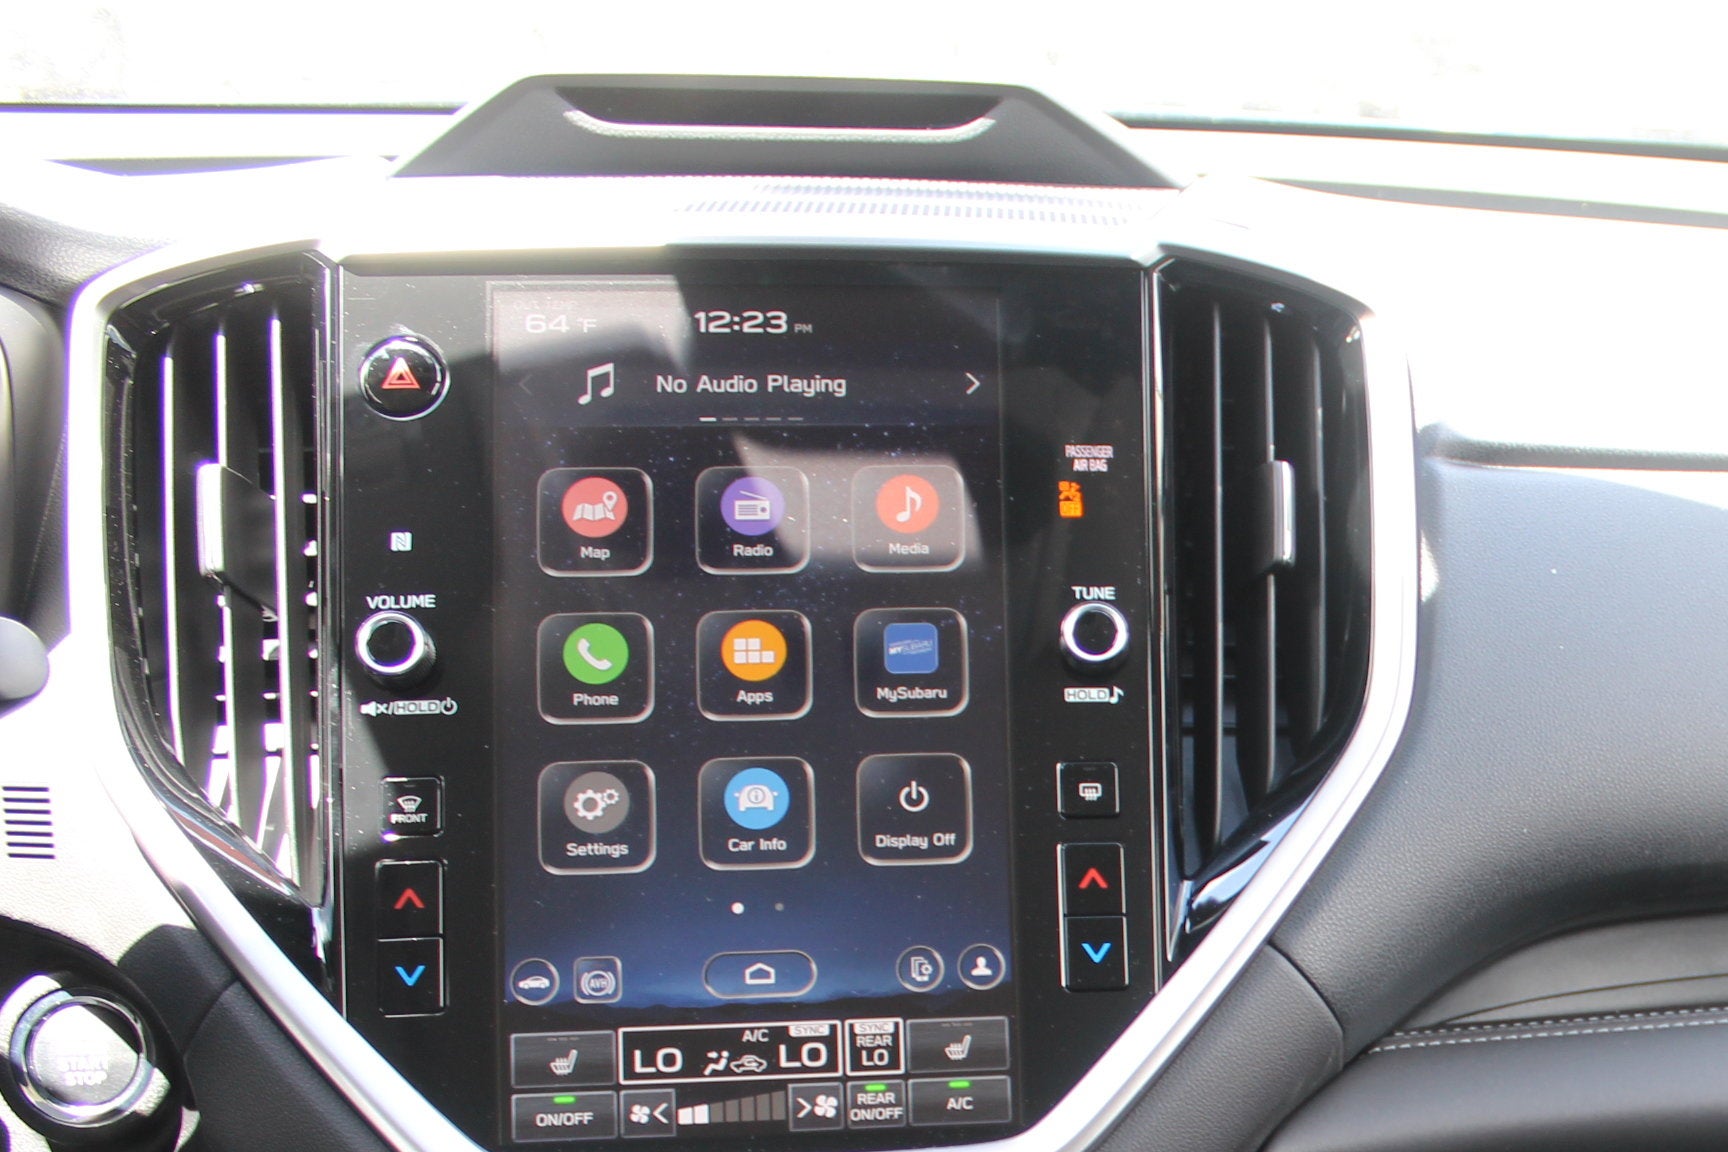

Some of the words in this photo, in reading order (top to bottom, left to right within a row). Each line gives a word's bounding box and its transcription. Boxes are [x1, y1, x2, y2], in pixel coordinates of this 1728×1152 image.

[524, 313, 569, 333] 64
[694, 310, 788, 334] 12:23
[793, 323, 812, 334] PM
[656, 375, 687, 393] No
[696, 374, 758, 393] Audio
[766, 373, 847, 397] Playing
[1065, 445, 1114, 458] PASSENGER
[1073, 460, 1087, 471] AIR
[1089, 459, 1108, 472] BAG
[580, 545, 611, 559] Map
[732, 543, 774, 557] Radio
[888, 541, 930, 554] Media
[1071, 586, 1115, 600] TUNE
[365, 594, 436, 609] VOLUME
[572, 693, 620, 707] Phone
[736, 689, 774, 704] Apps
[876, 686, 948, 703] MySubaru
[1065, 688, 1109, 701] HOLD
[389, 813, 428, 824] FRONT
[727, 837, 754, 853] Car
[759, 836, 788, 852] Info
[874, 833, 929, 851] Display
[932, 832, 956, 848] Off
[565, 842, 629, 860] Settings
[588, 976, 610, 989] AVH
[794, 1023, 828, 1035] SYNC
[858, 1023, 891, 1034] SYNC
[741, 1029, 770, 1043] A/C
[856, 1035, 893, 1048] REAR
[633, 1046, 684, 1074] LO
[778, 1041, 828, 1068] LO
[861, 1049, 889, 1067] LO
[857, 1092, 896, 1105] REAR
[946, 1097, 974, 1110] A/C
[535, 1111, 594, 1128] ON/OFF
[850, 1106, 904, 1121] ON/OFF
